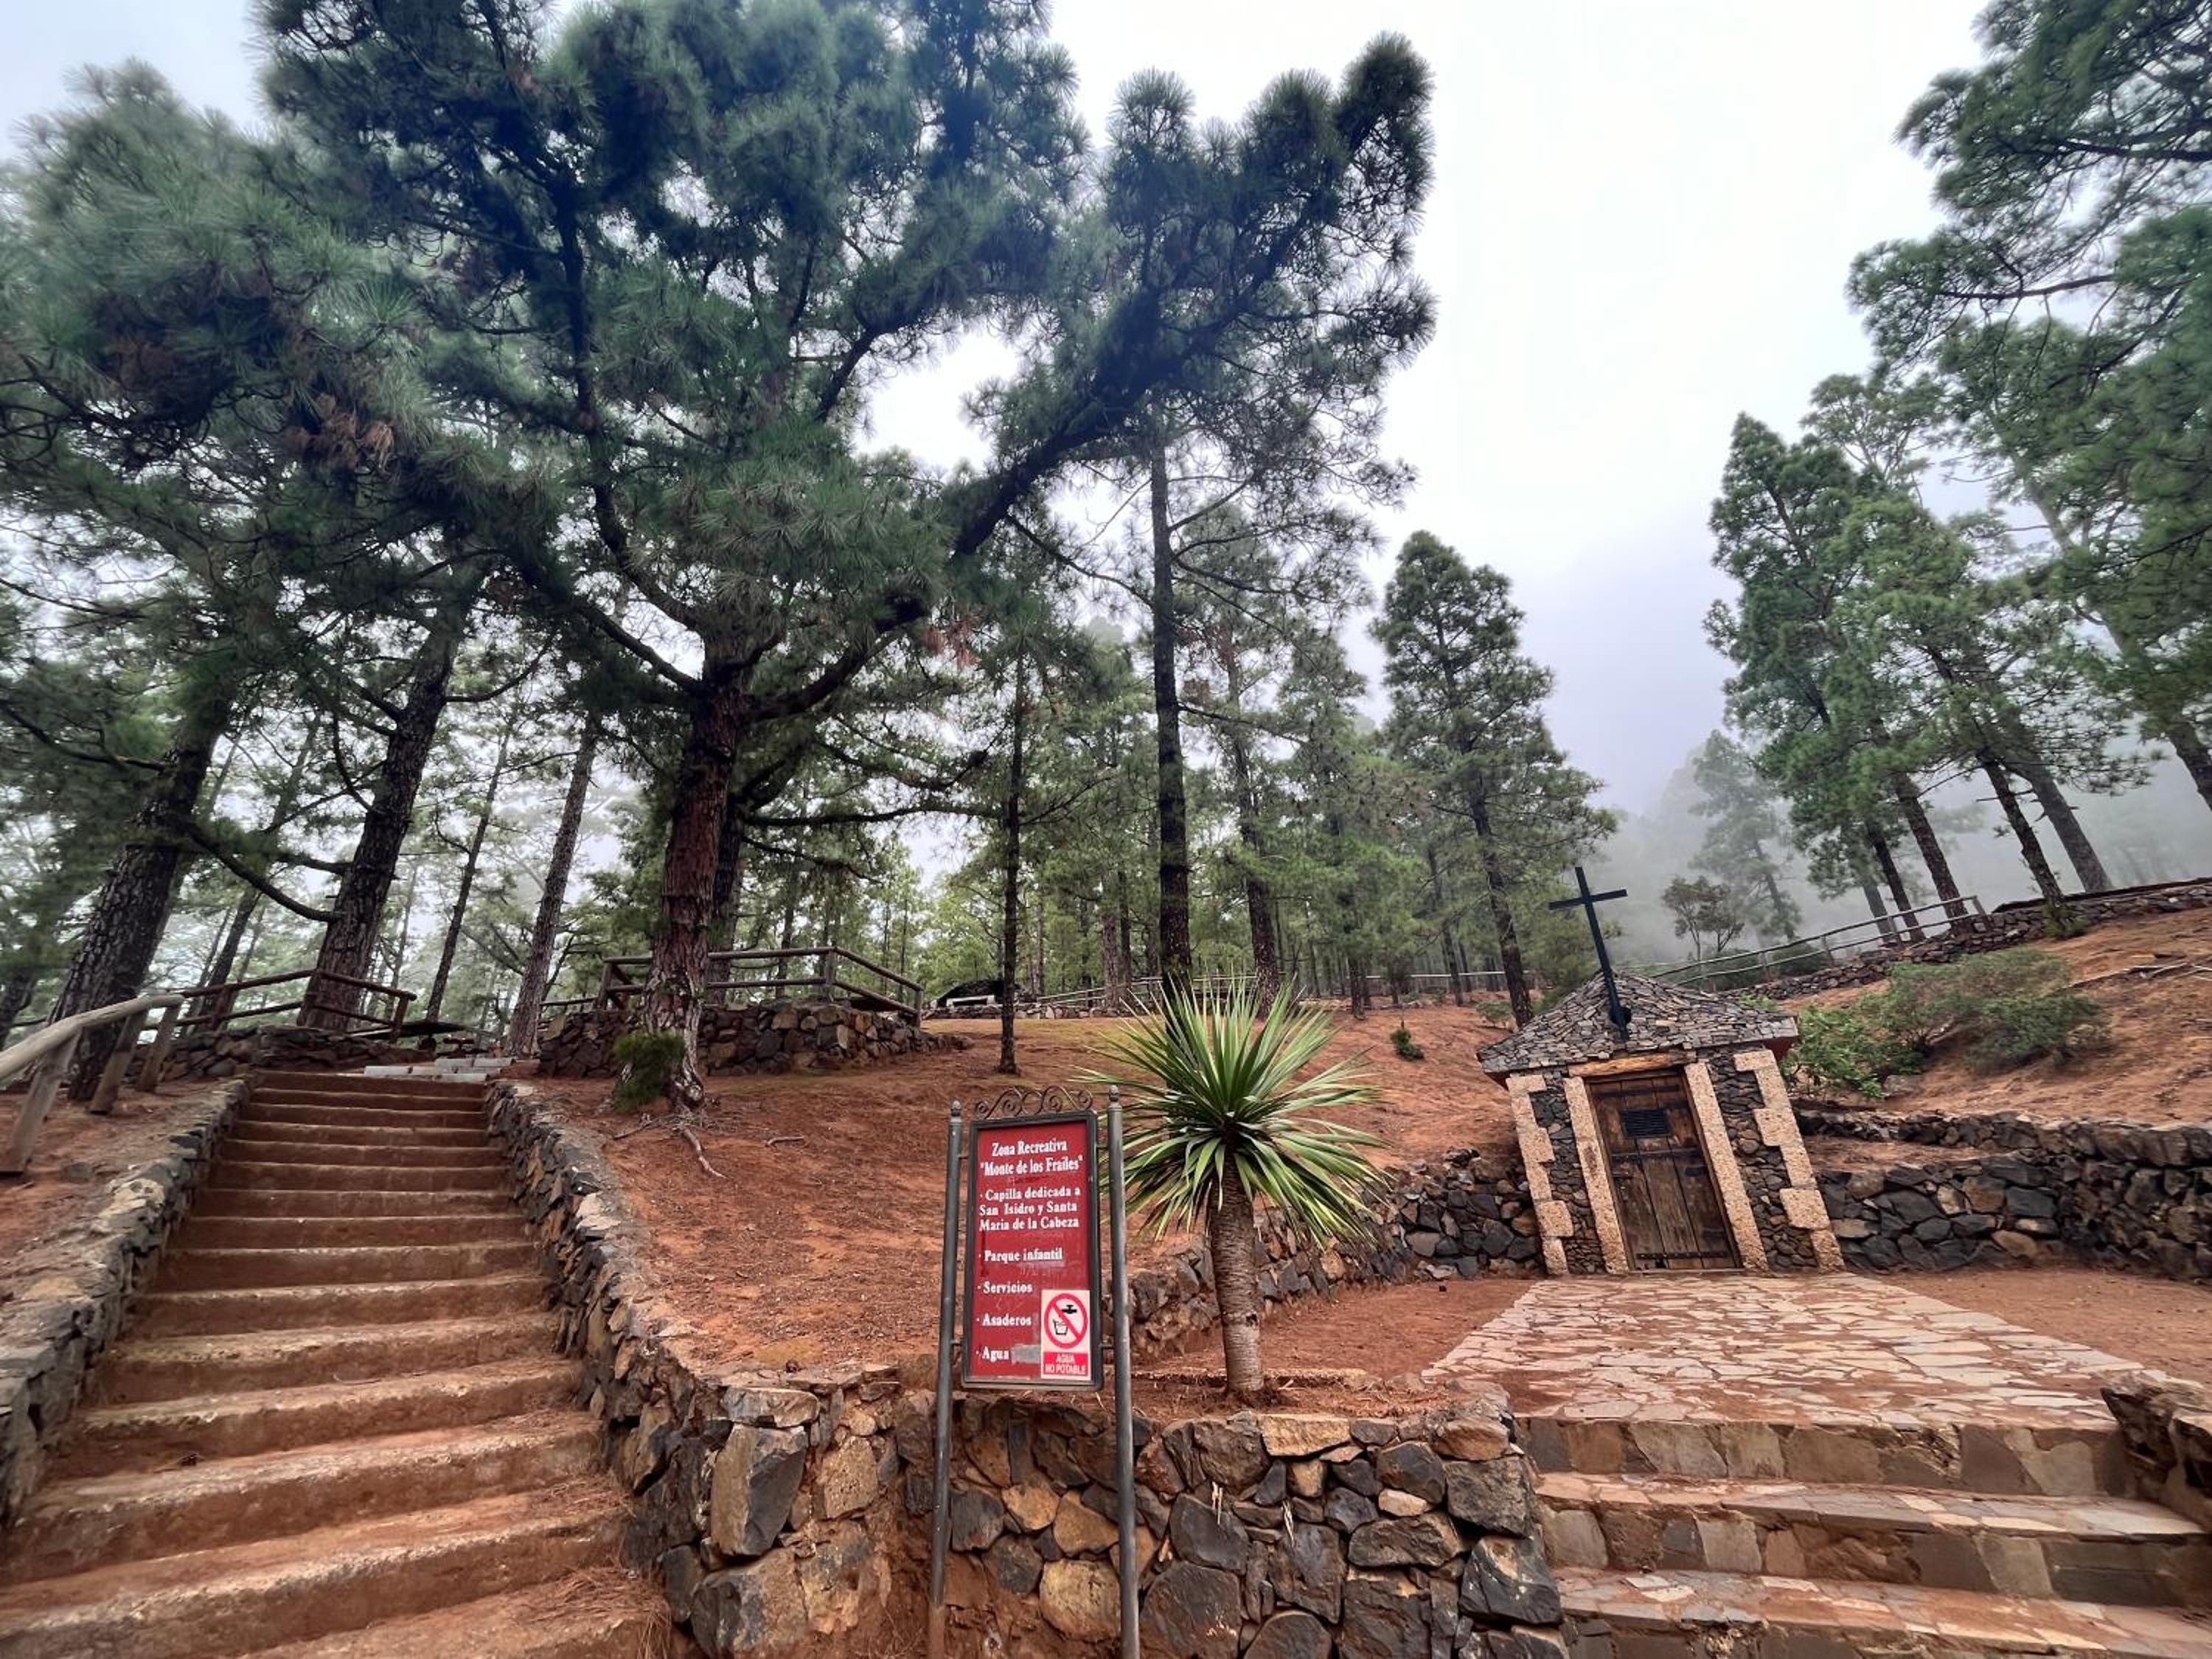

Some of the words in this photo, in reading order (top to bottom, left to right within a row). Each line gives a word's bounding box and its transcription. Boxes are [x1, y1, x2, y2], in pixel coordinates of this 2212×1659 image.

[992, 1142, 1015, 1156] Zona
[1018, 1138, 1067, 1155] Recreativa
[1017, 1160, 1027, 1174] de
[1030, 1158, 1043, 1172] los
[984, 1189, 1022, 1202] Capilla
[1024, 1186, 1071, 1199] dedicada
[1074, 1186, 1081, 1195] a
[979, 1204, 999, 1216] San
[1004, 1203, 1034, 1215] Isidro
[1037, 1204, 1044, 1215] y
[1046, 1200, 1077, 1213] Santa
[1012, 1218, 1025, 1230] de
[1028, 1217, 1037, 1229] la
[1040, 1217, 1079, 1228] Cabeza
[984, 1250, 1020, 1264] Parque
[1023, 1247, 1062, 1261] infantil
[983, 1281, 1032, 1293] Servicios
[982, 1313, 1032, 1326] Asaderos
[981, 1346, 1009, 1362] Agua
[1055, 1354, 1075, 1363] AGUA
[1045, 1365, 1054, 1374] NO
[1056, 1365, 1086, 1375] POTABLE
